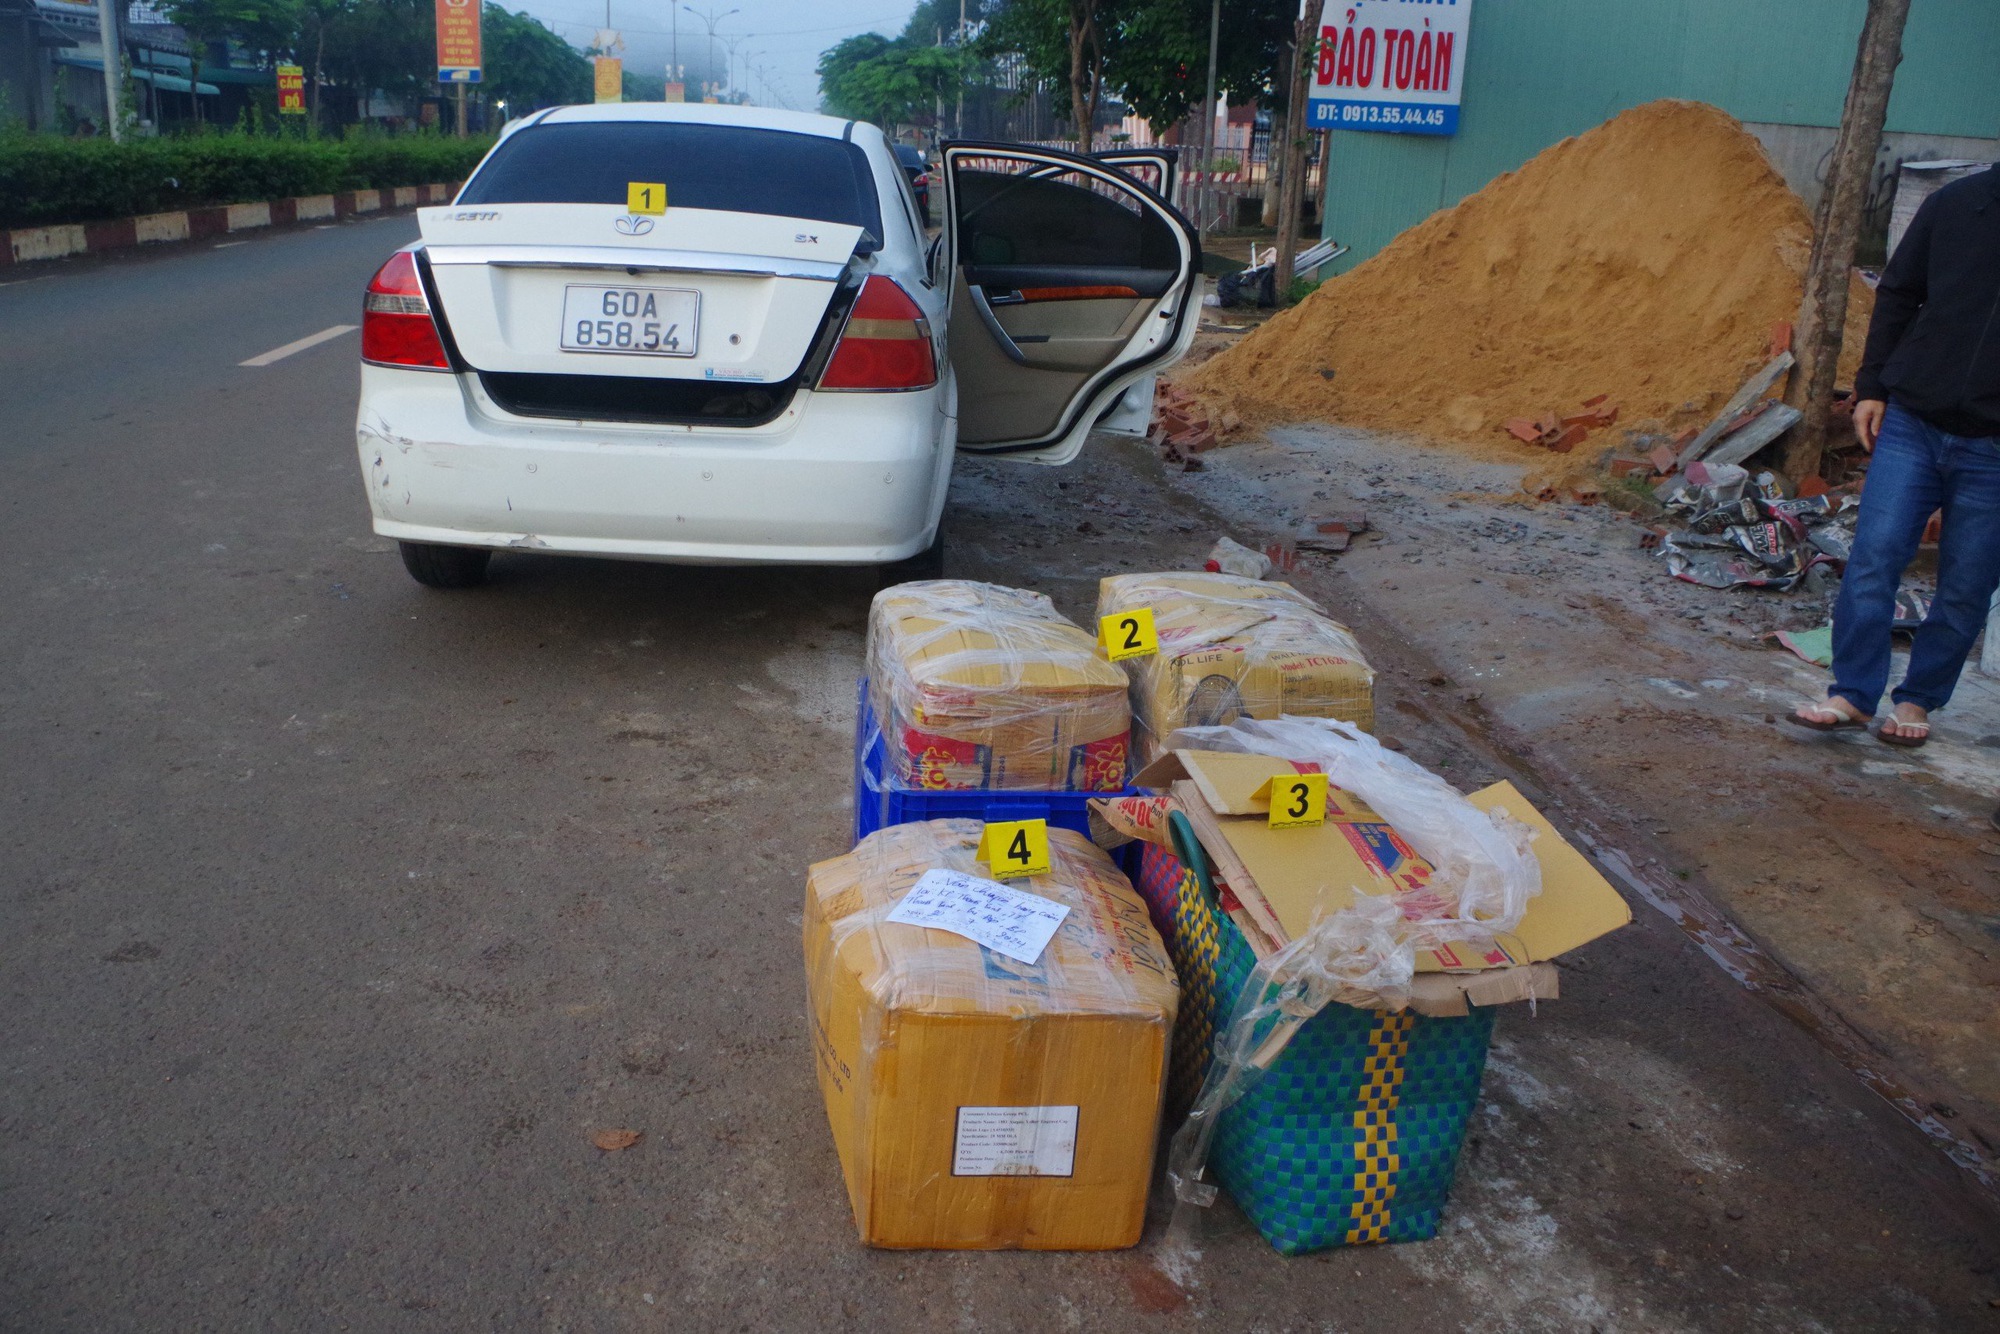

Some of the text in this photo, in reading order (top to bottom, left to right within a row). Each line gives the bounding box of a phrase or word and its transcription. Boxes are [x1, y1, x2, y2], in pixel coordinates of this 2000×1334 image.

[1317, 8, 1454, 91] BẢO TOÀN
[1317, 104, 1444, 126] ĐT: 0913.55.44.45
[641, 188, 650, 209] 1
[602, 290, 657, 319] 60A
[576, 320, 680, 350] 858.54
[1120, 618, 1142, 650] 2
[1197, 654, 1223, 664] LIFE
[1287, 783, 1309, 818] 3
[1008, 829, 1031, 865] 4
